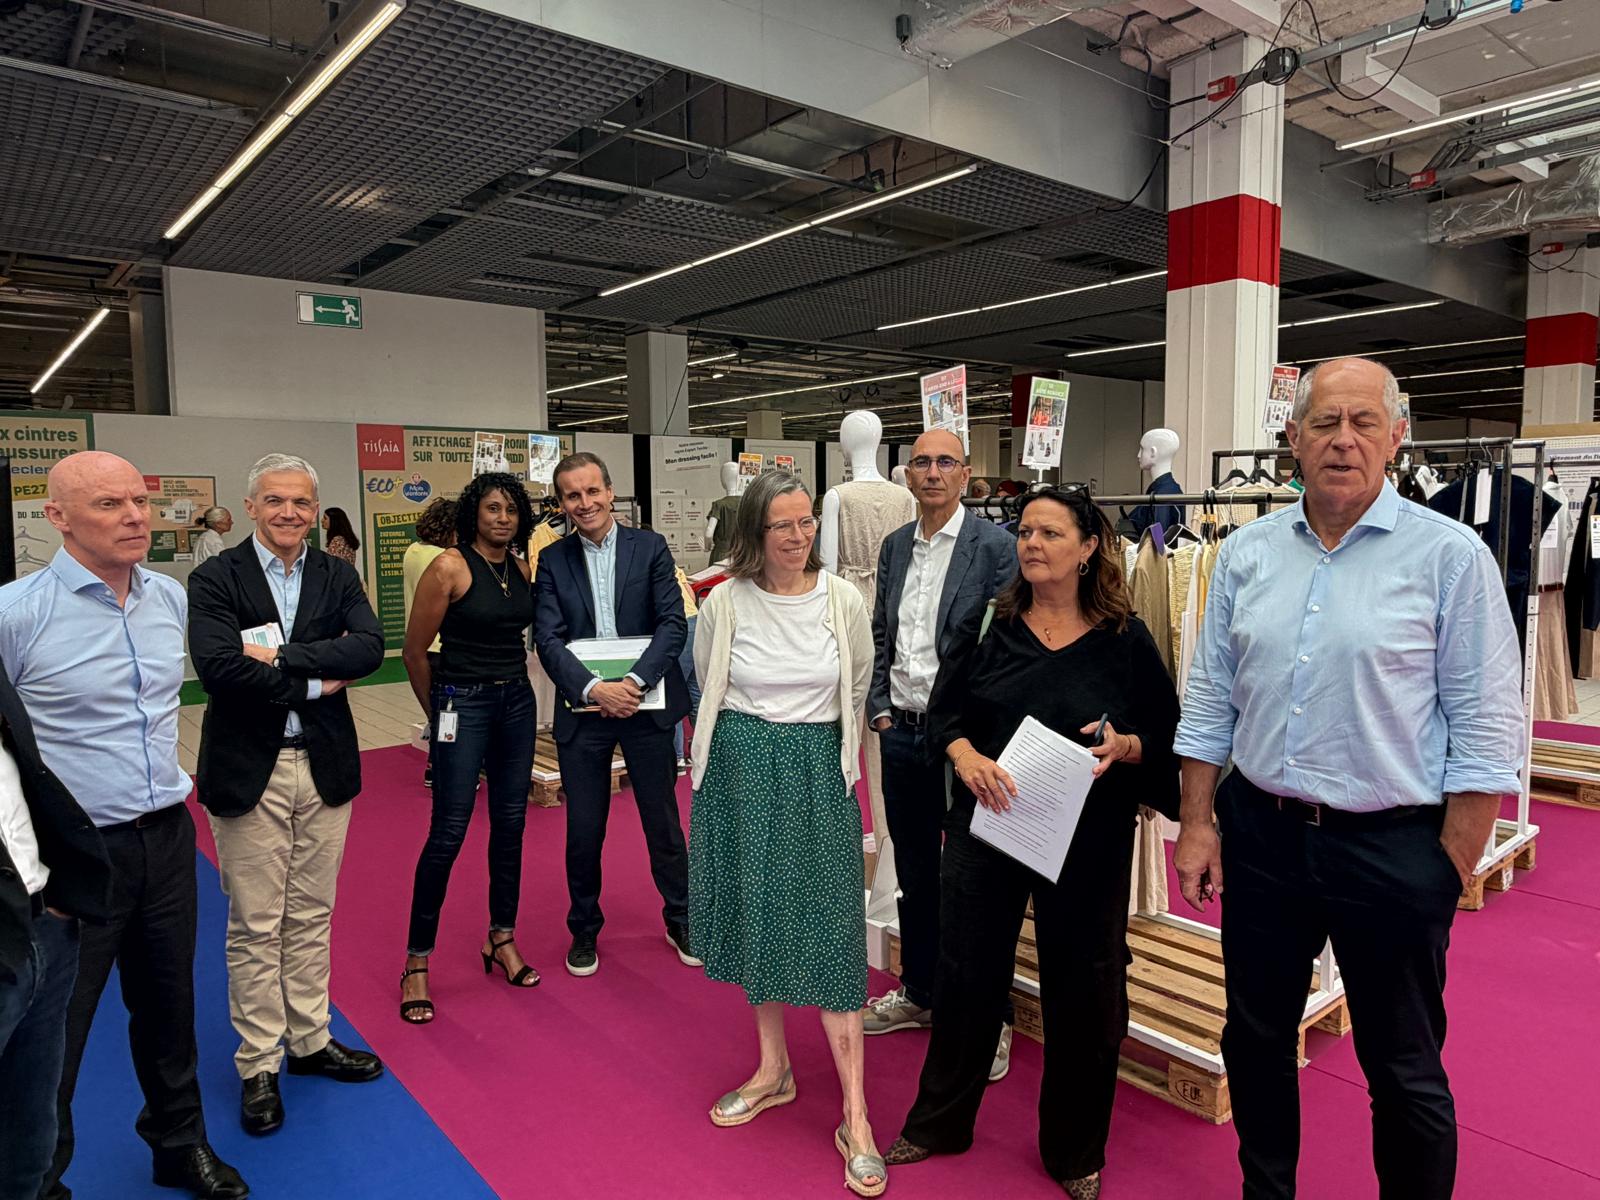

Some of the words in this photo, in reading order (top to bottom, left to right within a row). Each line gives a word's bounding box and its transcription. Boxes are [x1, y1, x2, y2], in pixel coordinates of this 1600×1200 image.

[14, 425, 78, 442] cintres
[412, 435, 472, 448] AFFICHAGE
[0, 447, 78, 460] ussure
[412, 450, 433, 462] SUR
[678, 454, 700, 463] dressing
[11, 465, 49, 475] ecler
[13, 484, 48, 497] PE27
[17, 511, 27, 519] DU
